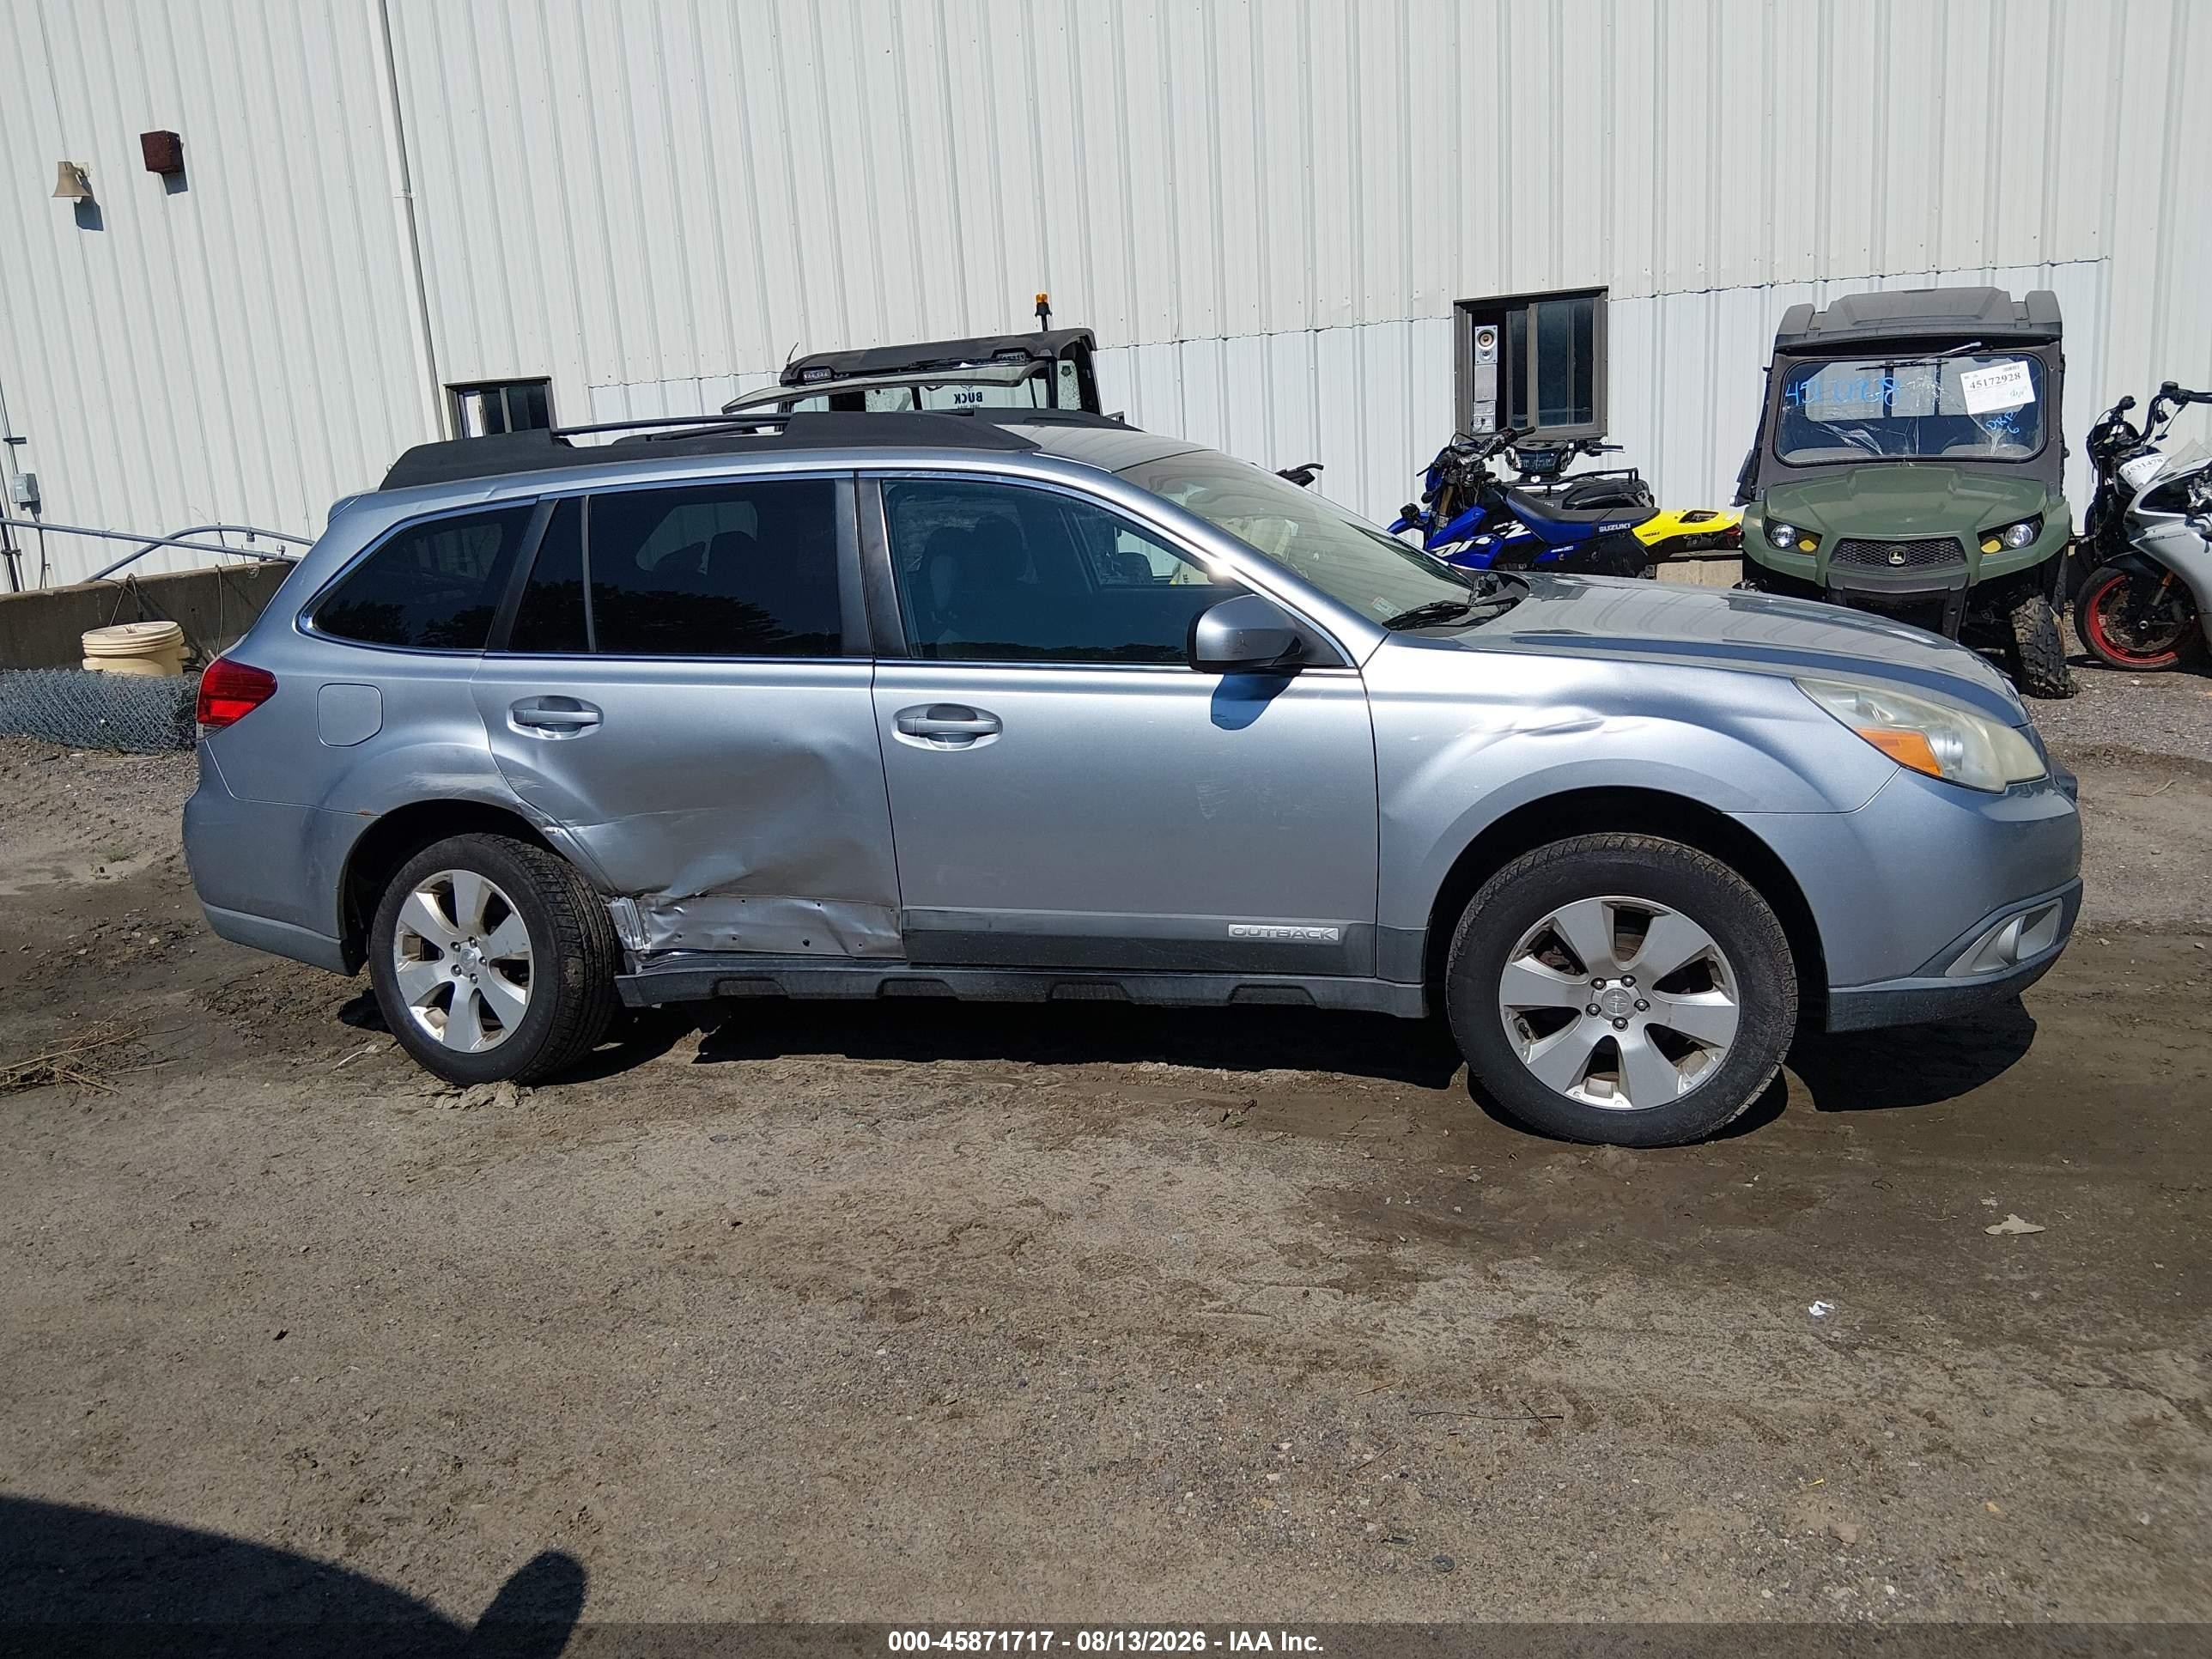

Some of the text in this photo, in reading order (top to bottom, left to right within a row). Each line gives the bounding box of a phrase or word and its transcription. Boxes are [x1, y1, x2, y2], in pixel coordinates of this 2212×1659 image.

[1970, 372, 2021, 389] 45172928
[1598, 522, 1632, 533] SUZUKI
[1231, 927, 1336, 940] OUTBACK
